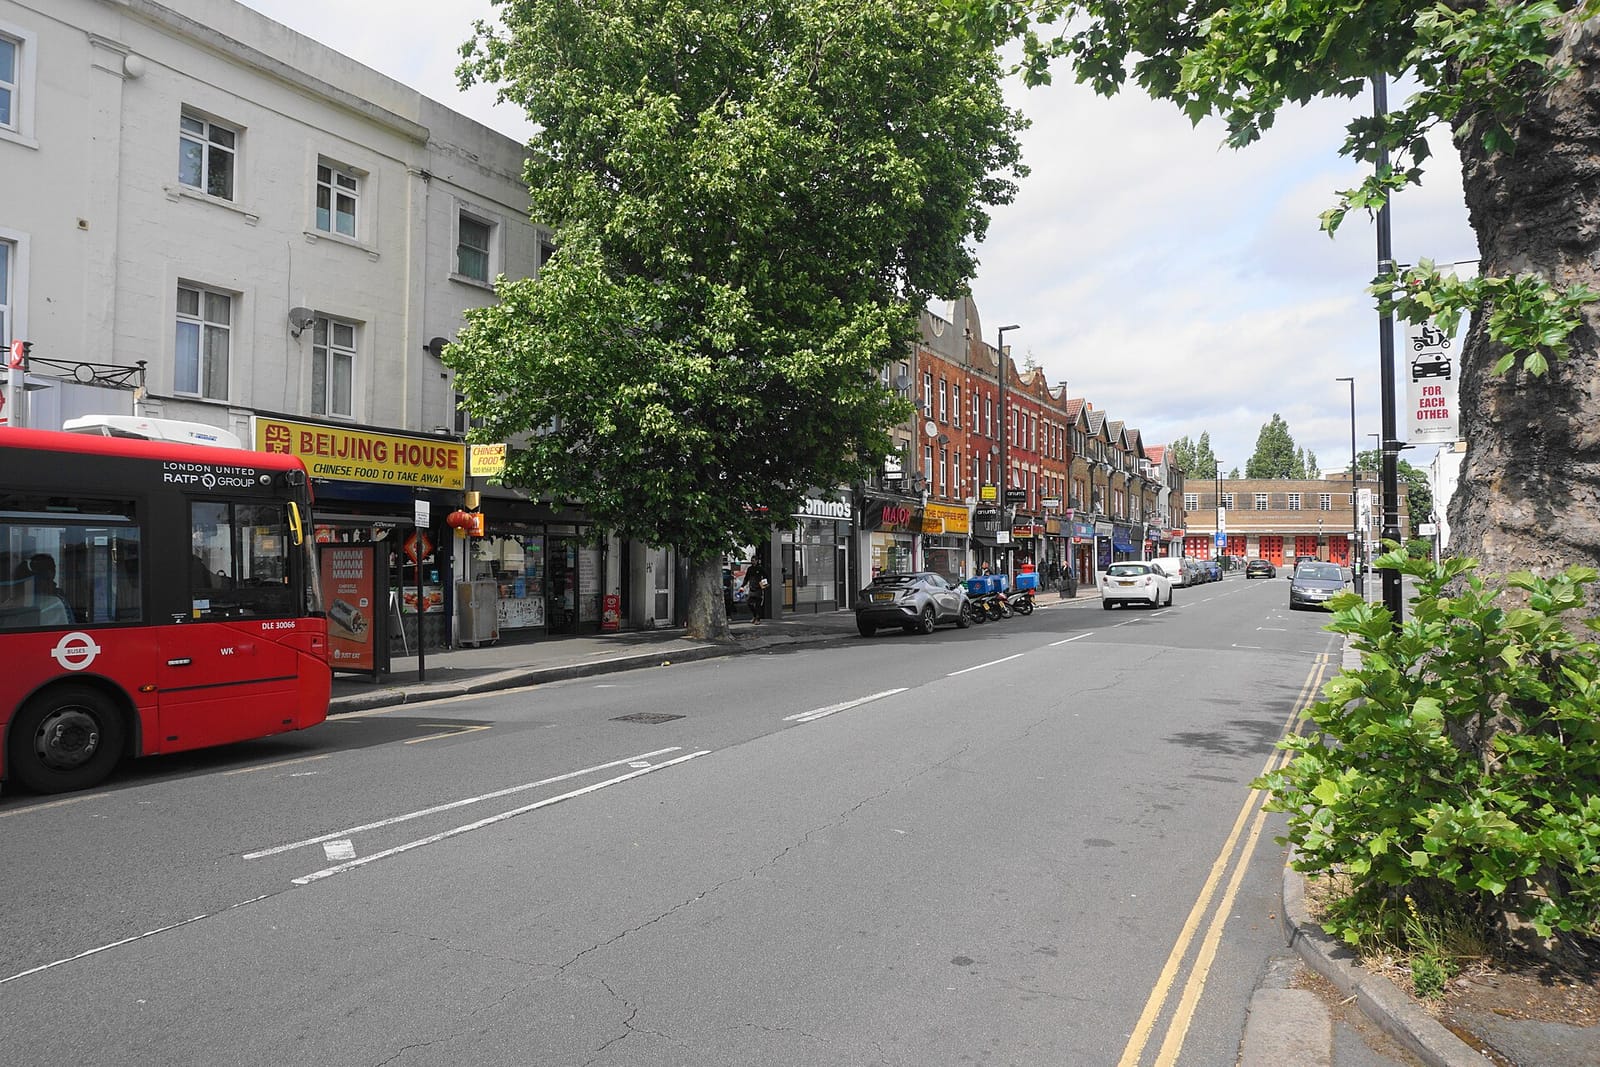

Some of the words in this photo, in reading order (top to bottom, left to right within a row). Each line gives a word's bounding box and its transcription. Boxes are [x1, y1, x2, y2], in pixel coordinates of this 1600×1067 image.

[11, 343, 19, 361] K
[1423, 386, 1442, 396] FOR
[1420, 397, 1445, 408] EACH
[1417, 409, 1449, 420] OTHER
[300, 431, 387, 462] BEIJING
[394, 442, 459, 470] HOUSE
[472, 446, 505, 456] CHINESE
[477, 456, 499, 466] FOOD
[163, 462, 211, 473] LONDON
[215, 466, 255, 476] UNITED
[313, 463, 352, 476] CHINESE
[354, 466, 379, 479] FOOD
[381, 469, 394, 481] TO
[396, 471, 419, 482] TAKE
[420, 472, 444, 485] AWAY
[163, 473, 199, 484] RATP
[217, 477, 255, 488] GROUP
[261, 622, 274, 630] DLE
[275, 621, 296, 629] 30066
[220, 647, 234, 656] WK
